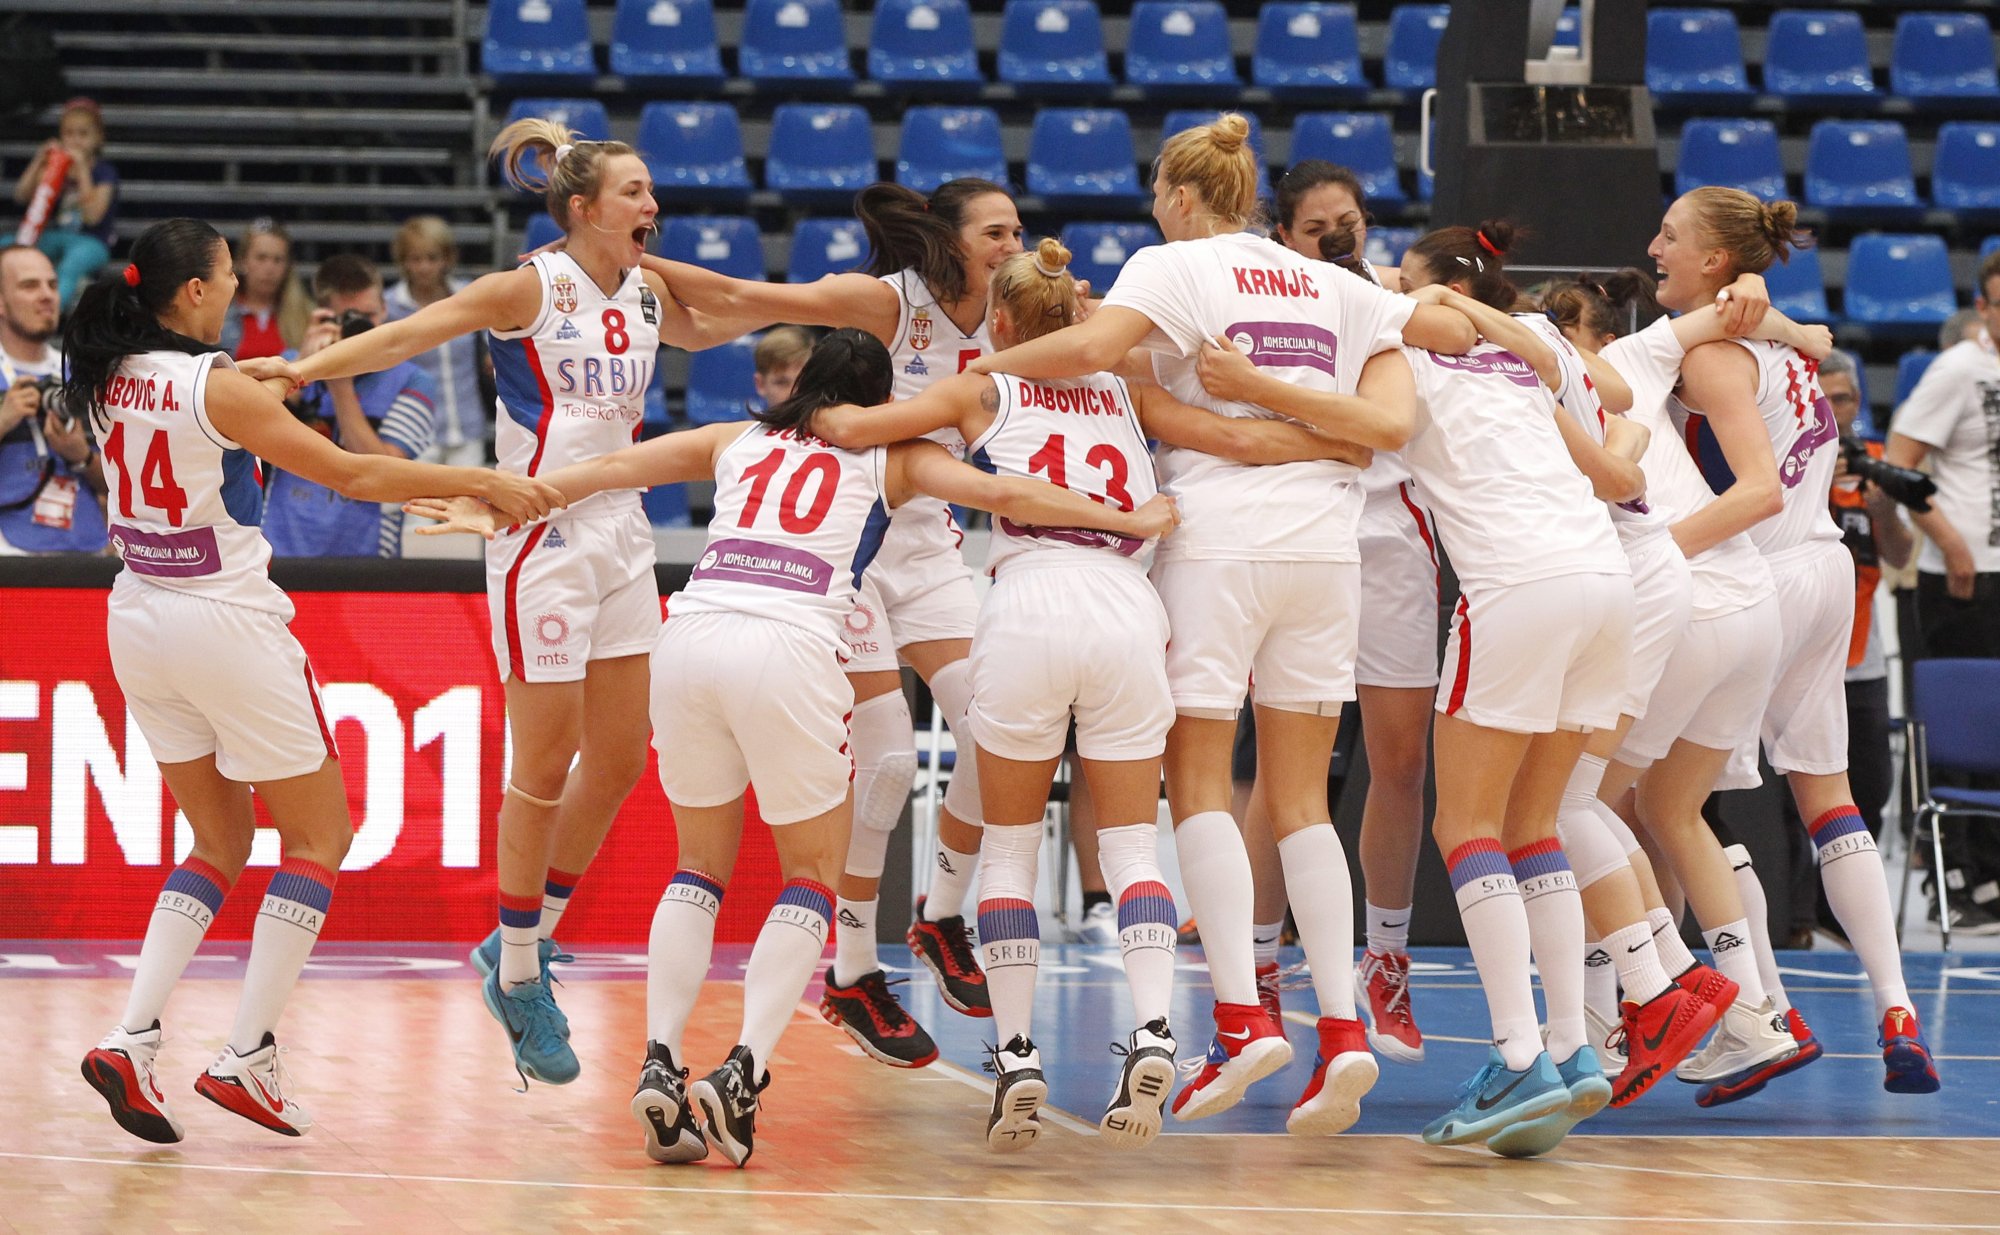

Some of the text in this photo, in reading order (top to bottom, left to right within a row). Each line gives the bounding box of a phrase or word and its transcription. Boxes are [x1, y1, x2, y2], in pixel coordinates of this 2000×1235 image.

[601, 308, 630, 355] 8
[96, 372, 179, 411] ABOVIĆ A.
[558, 357, 655, 400] SRBIJ
[1019, 382, 1123, 417] DABOVIĆ M.
[104, 421, 188, 528] 14
[1028, 434, 1134, 512] 13
[736, 447, 841, 535] 10
[723, 552, 813, 580] KOMERCIJALNA BANKA
[537, 652, 569, 666] mts
[1819, 835, 1873, 860] RBIJA
[157, 895, 209, 927] RBIJA
[663, 887, 716, 914] RBIJA
[1712, 937, 1746, 954] PEAK
